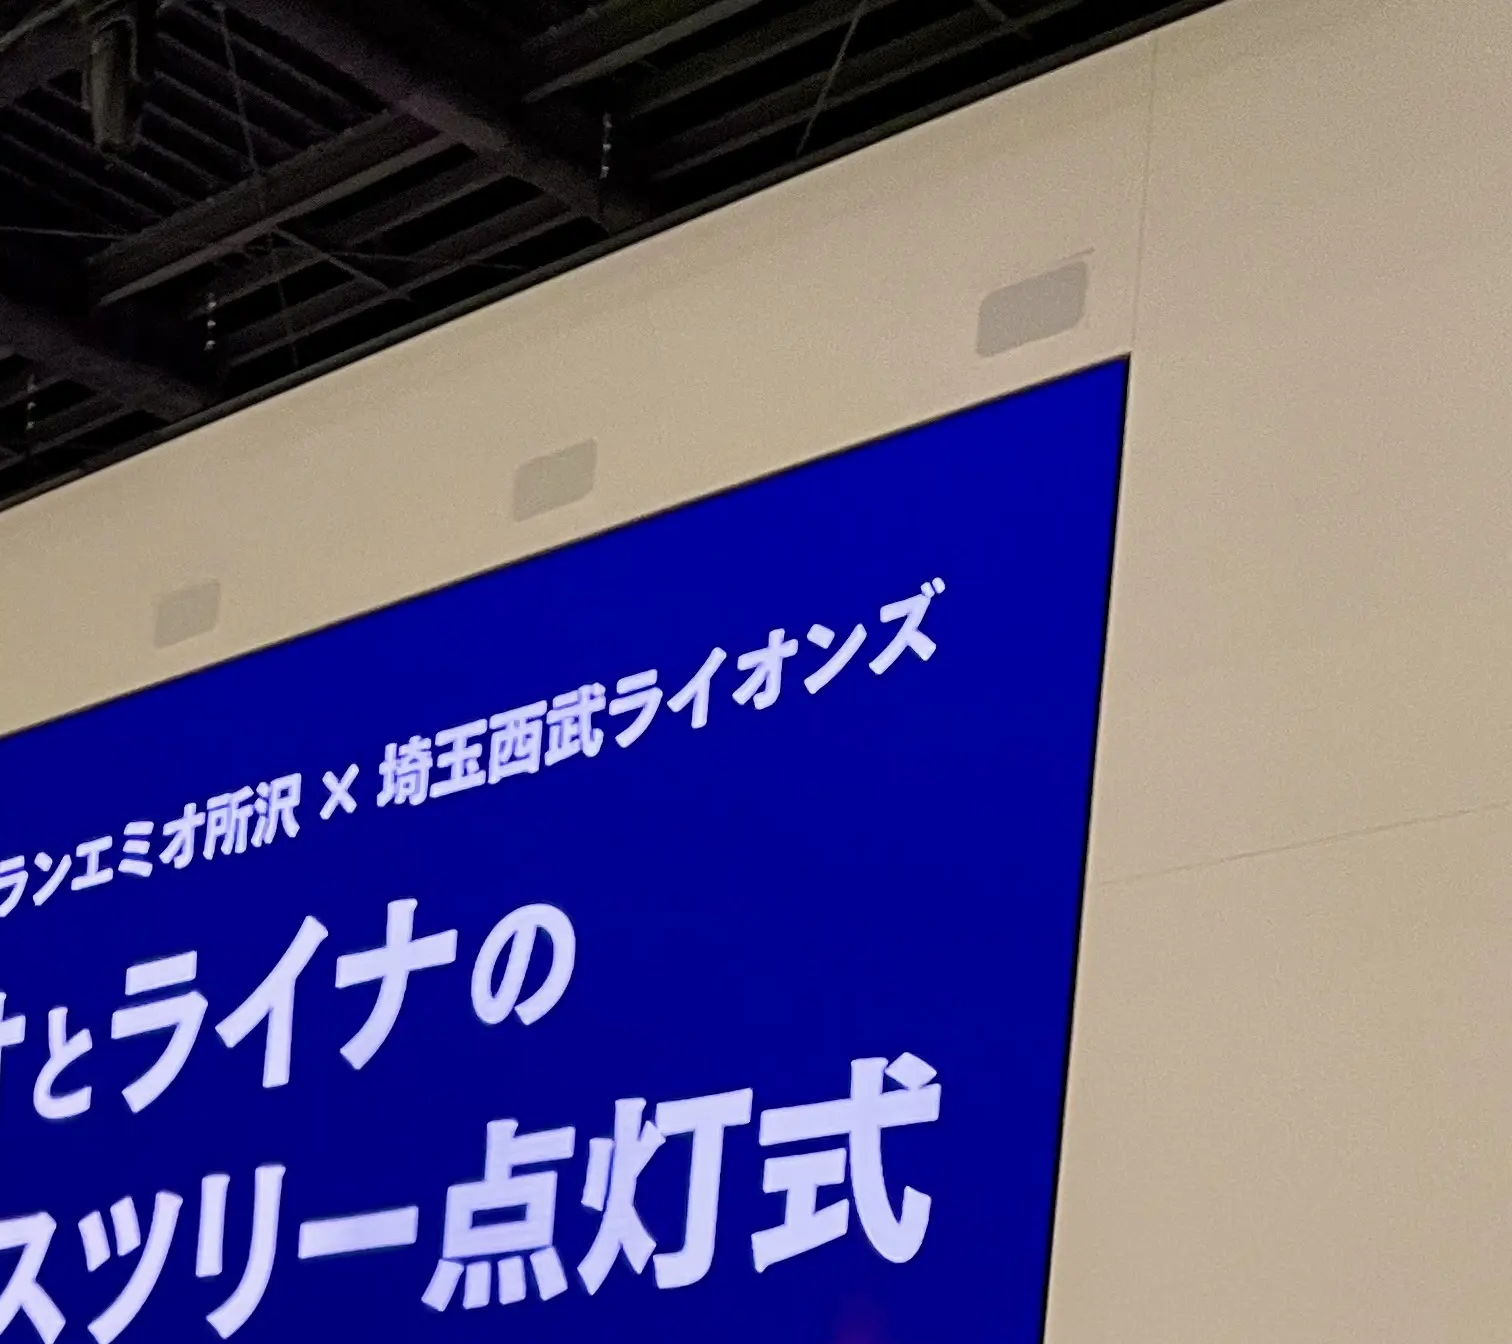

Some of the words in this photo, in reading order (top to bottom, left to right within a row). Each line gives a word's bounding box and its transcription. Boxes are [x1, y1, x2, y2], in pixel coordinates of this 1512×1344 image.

[375, 576, 947, 809] 埼玉西武ライオンズ
